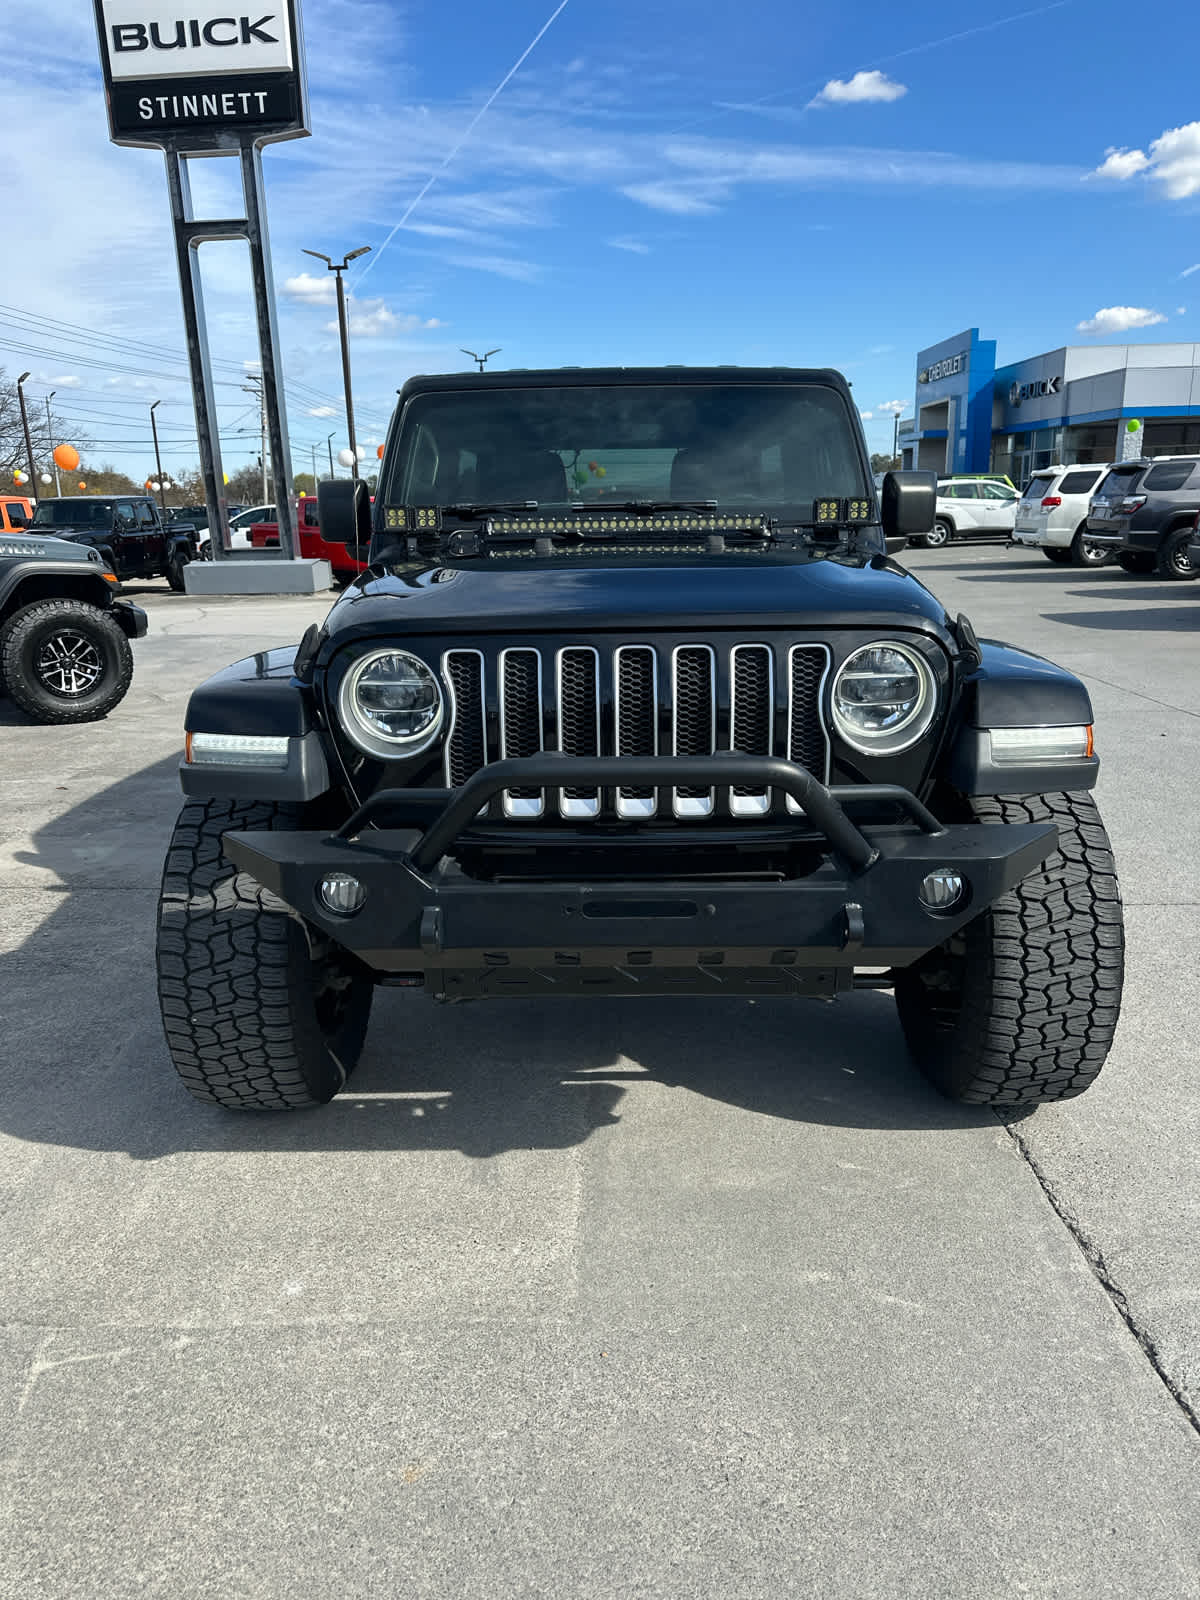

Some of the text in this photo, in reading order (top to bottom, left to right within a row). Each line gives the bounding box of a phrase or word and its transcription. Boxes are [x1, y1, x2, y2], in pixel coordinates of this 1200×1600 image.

[111, 15, 279, 52] BUICK
[138, 92, 268, 120] STINNETT
[928, 355, 962, 382] CHEVROLET
[1020, 377, 1057, 400] BUICK
